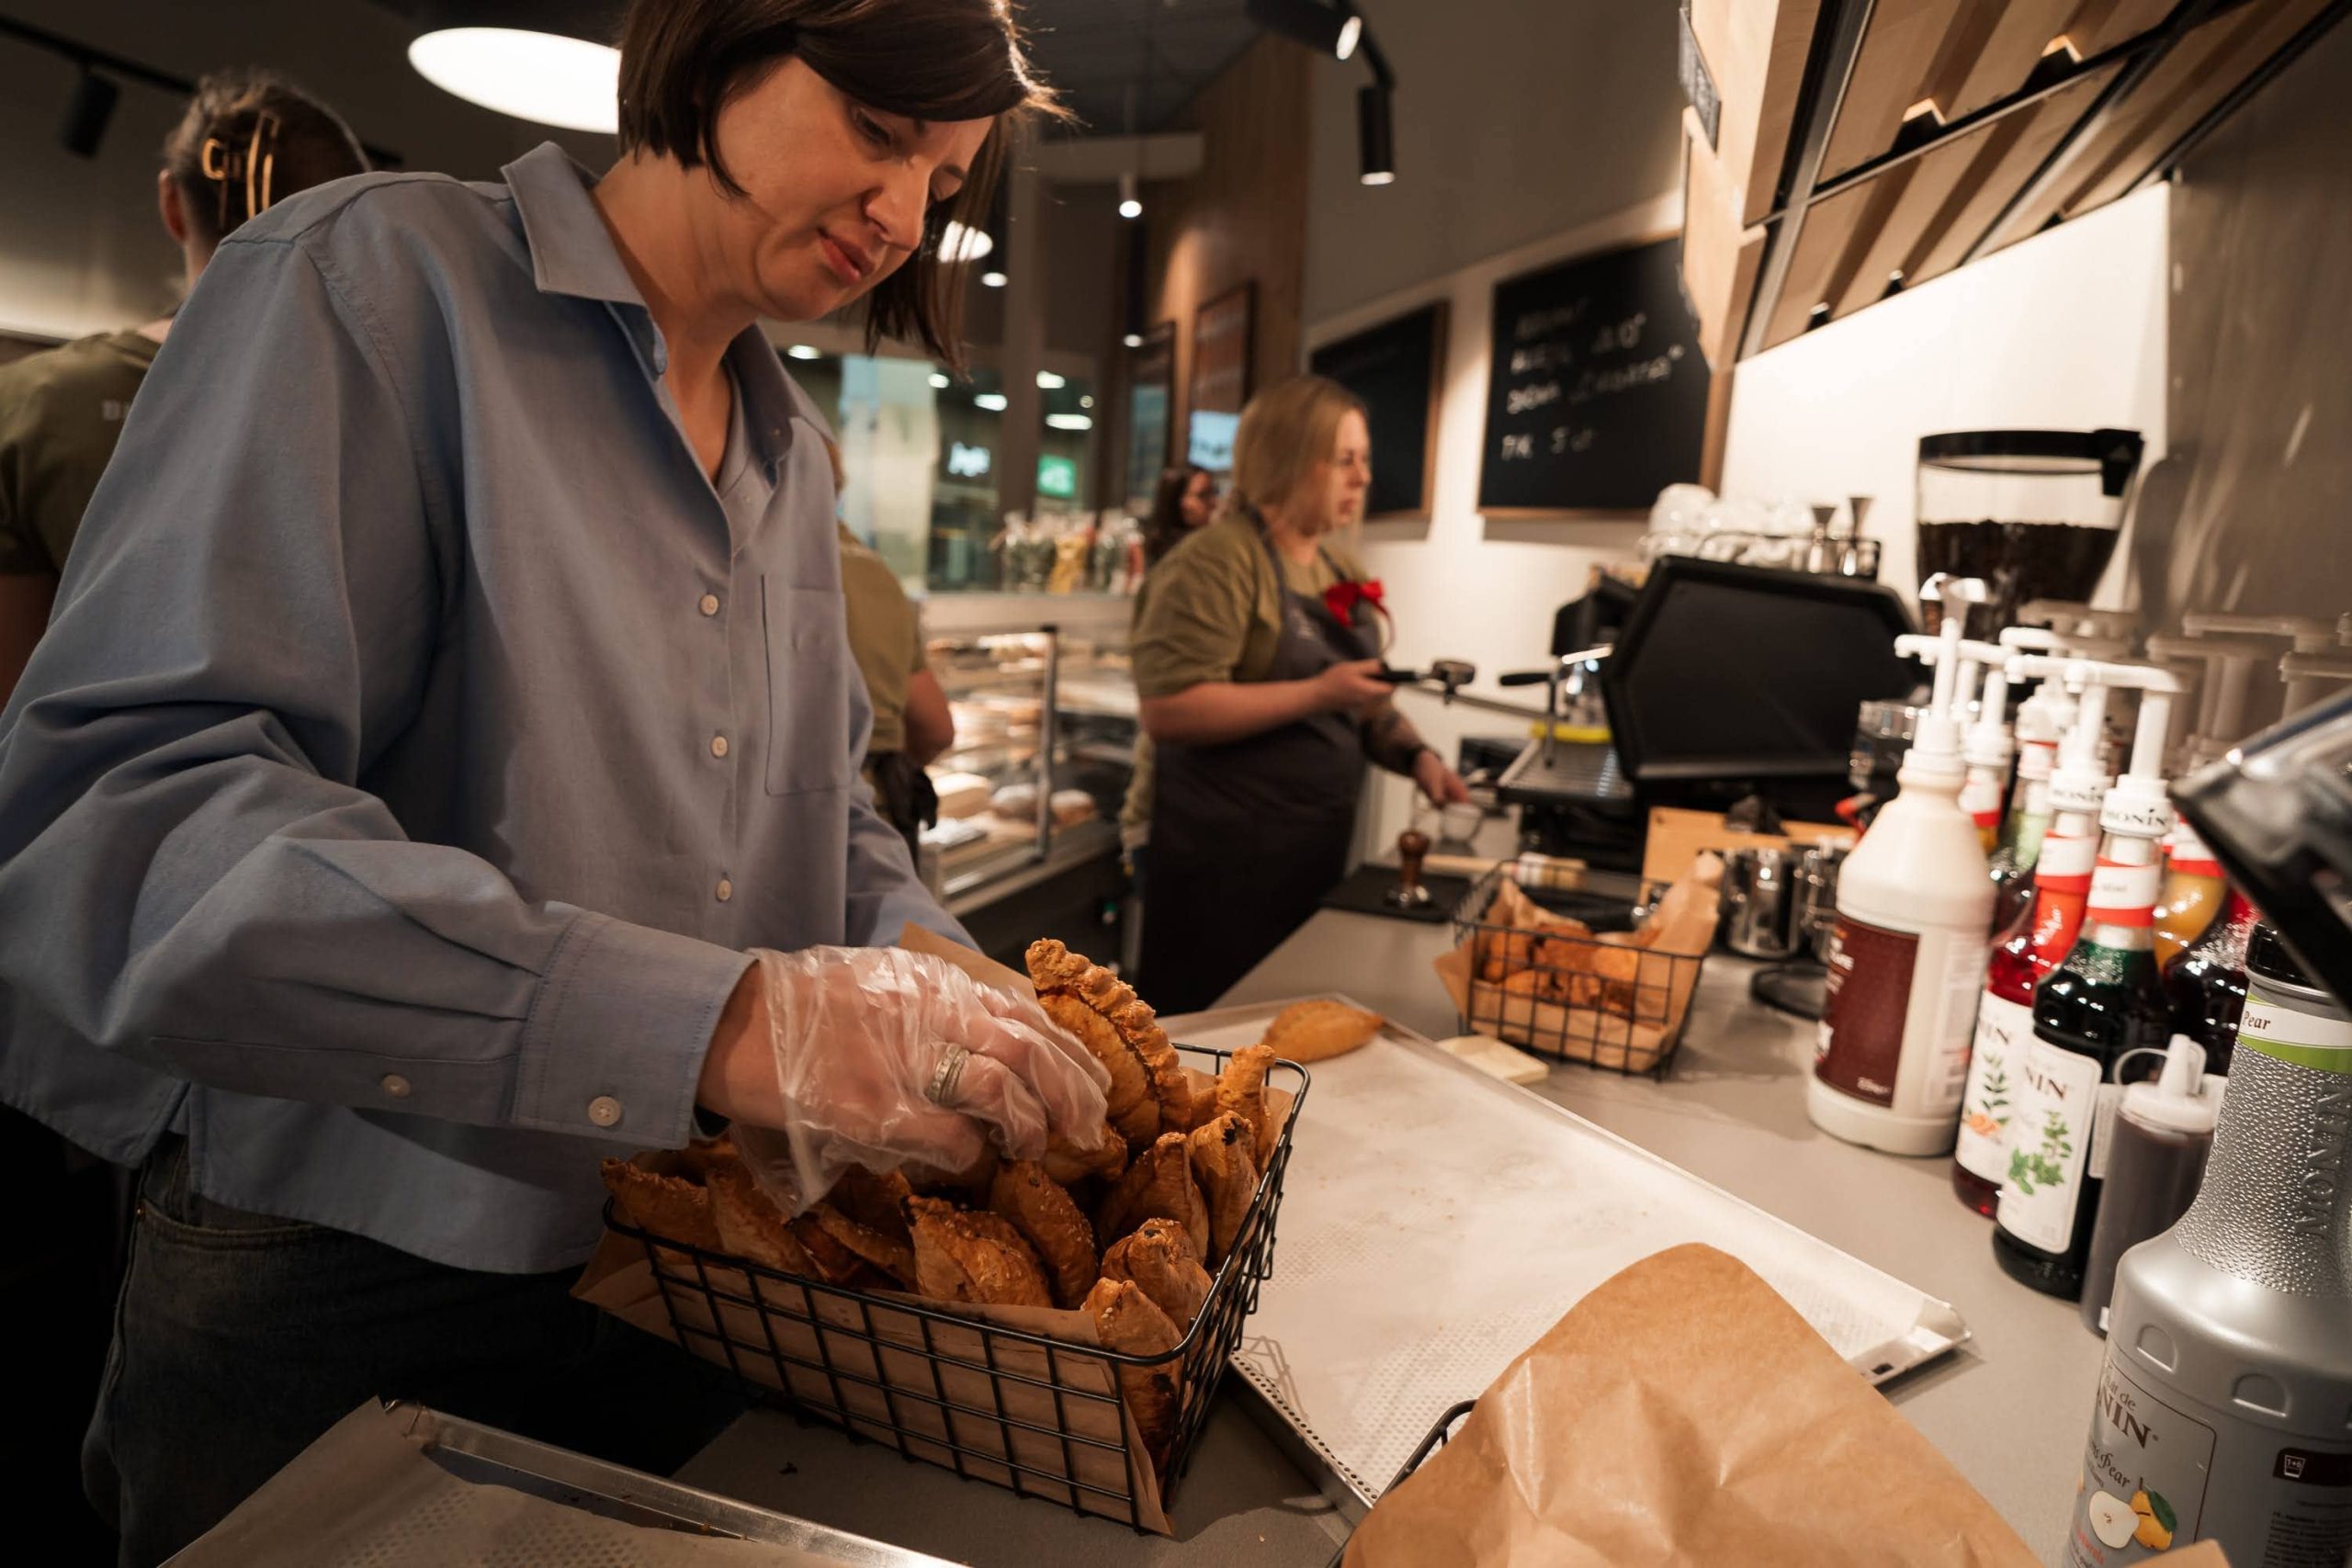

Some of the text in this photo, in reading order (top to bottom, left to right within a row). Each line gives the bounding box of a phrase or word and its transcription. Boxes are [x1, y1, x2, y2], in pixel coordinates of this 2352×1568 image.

[2243, 1010, 2271, 1031] Pear
[2098, 1385, 2152, 1450] NIN
[2099, 1453, 2131, 1487] Pear
